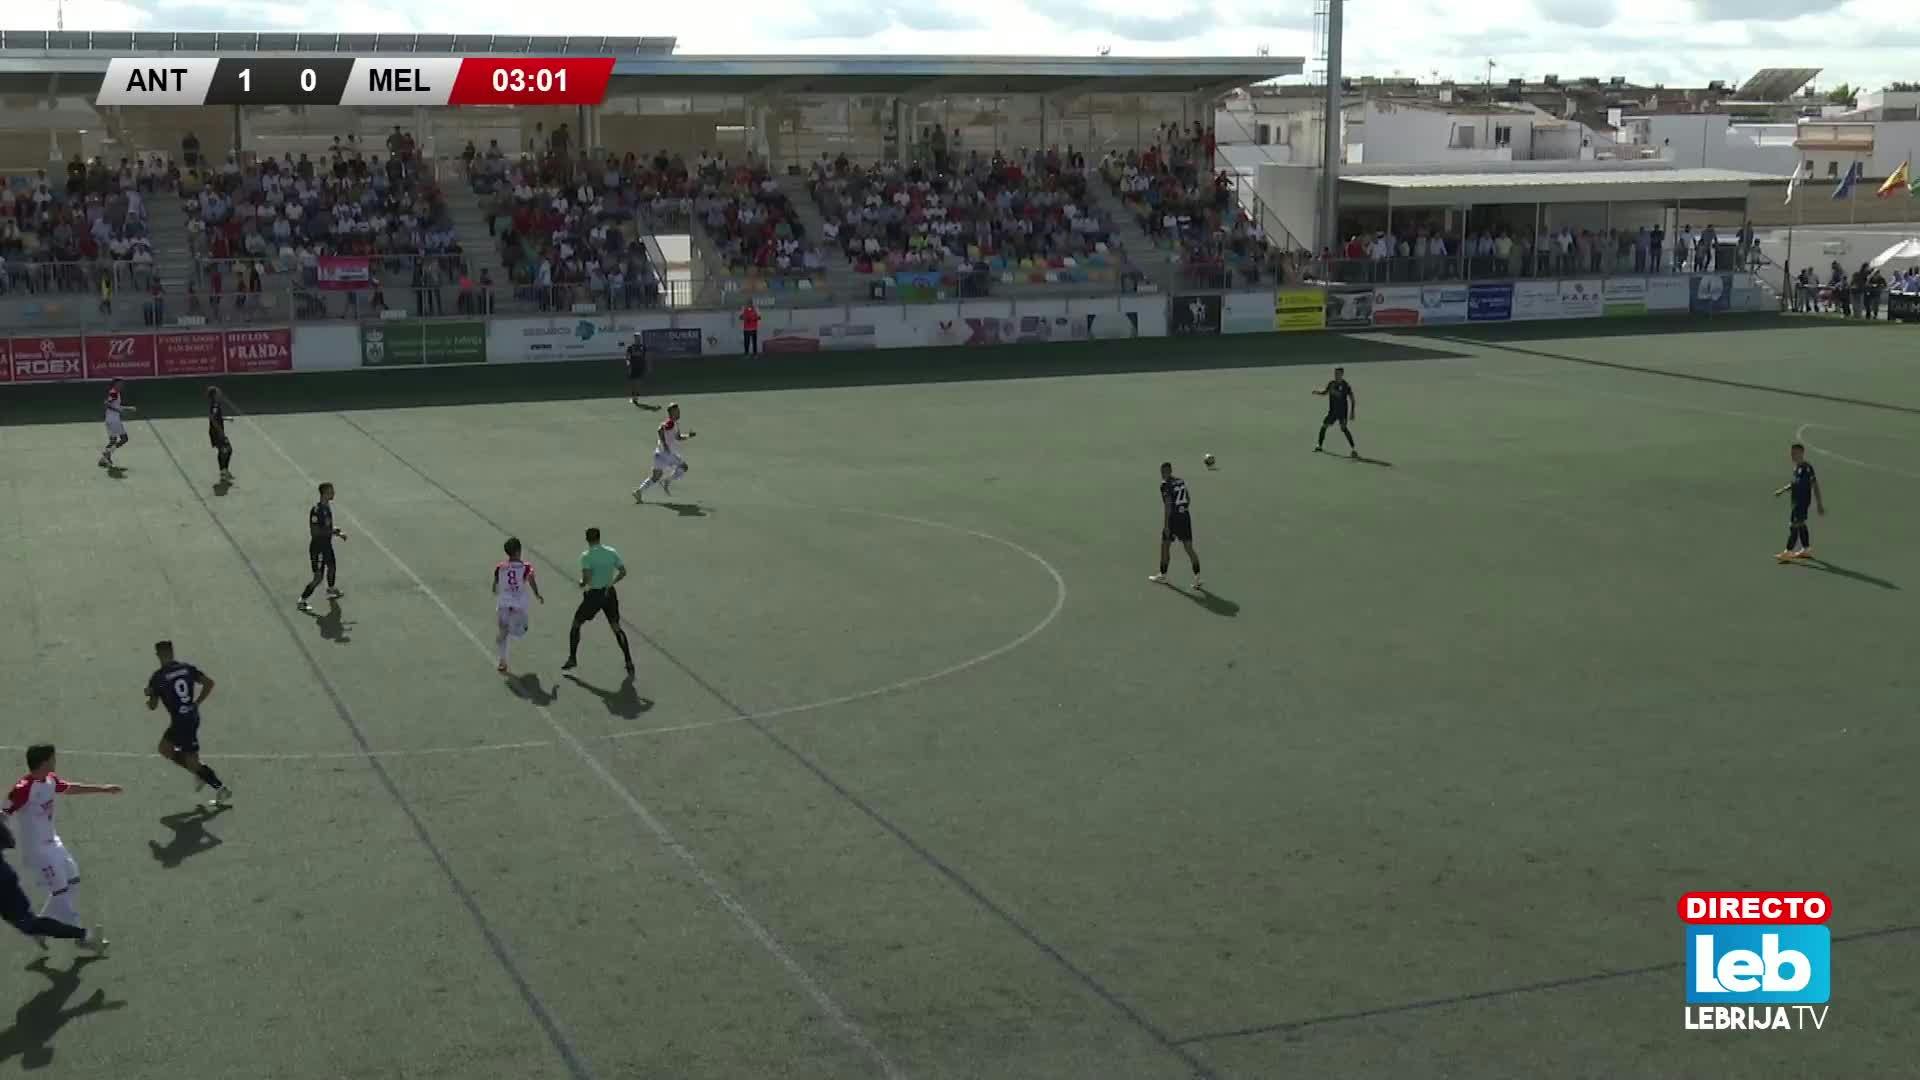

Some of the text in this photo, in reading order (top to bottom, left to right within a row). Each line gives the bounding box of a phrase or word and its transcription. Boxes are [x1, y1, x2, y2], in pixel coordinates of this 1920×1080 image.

[15, 360, 80, 375] ROEX
[507, 570, 518, 585] 8
[174, 678, 191, 703] 9
